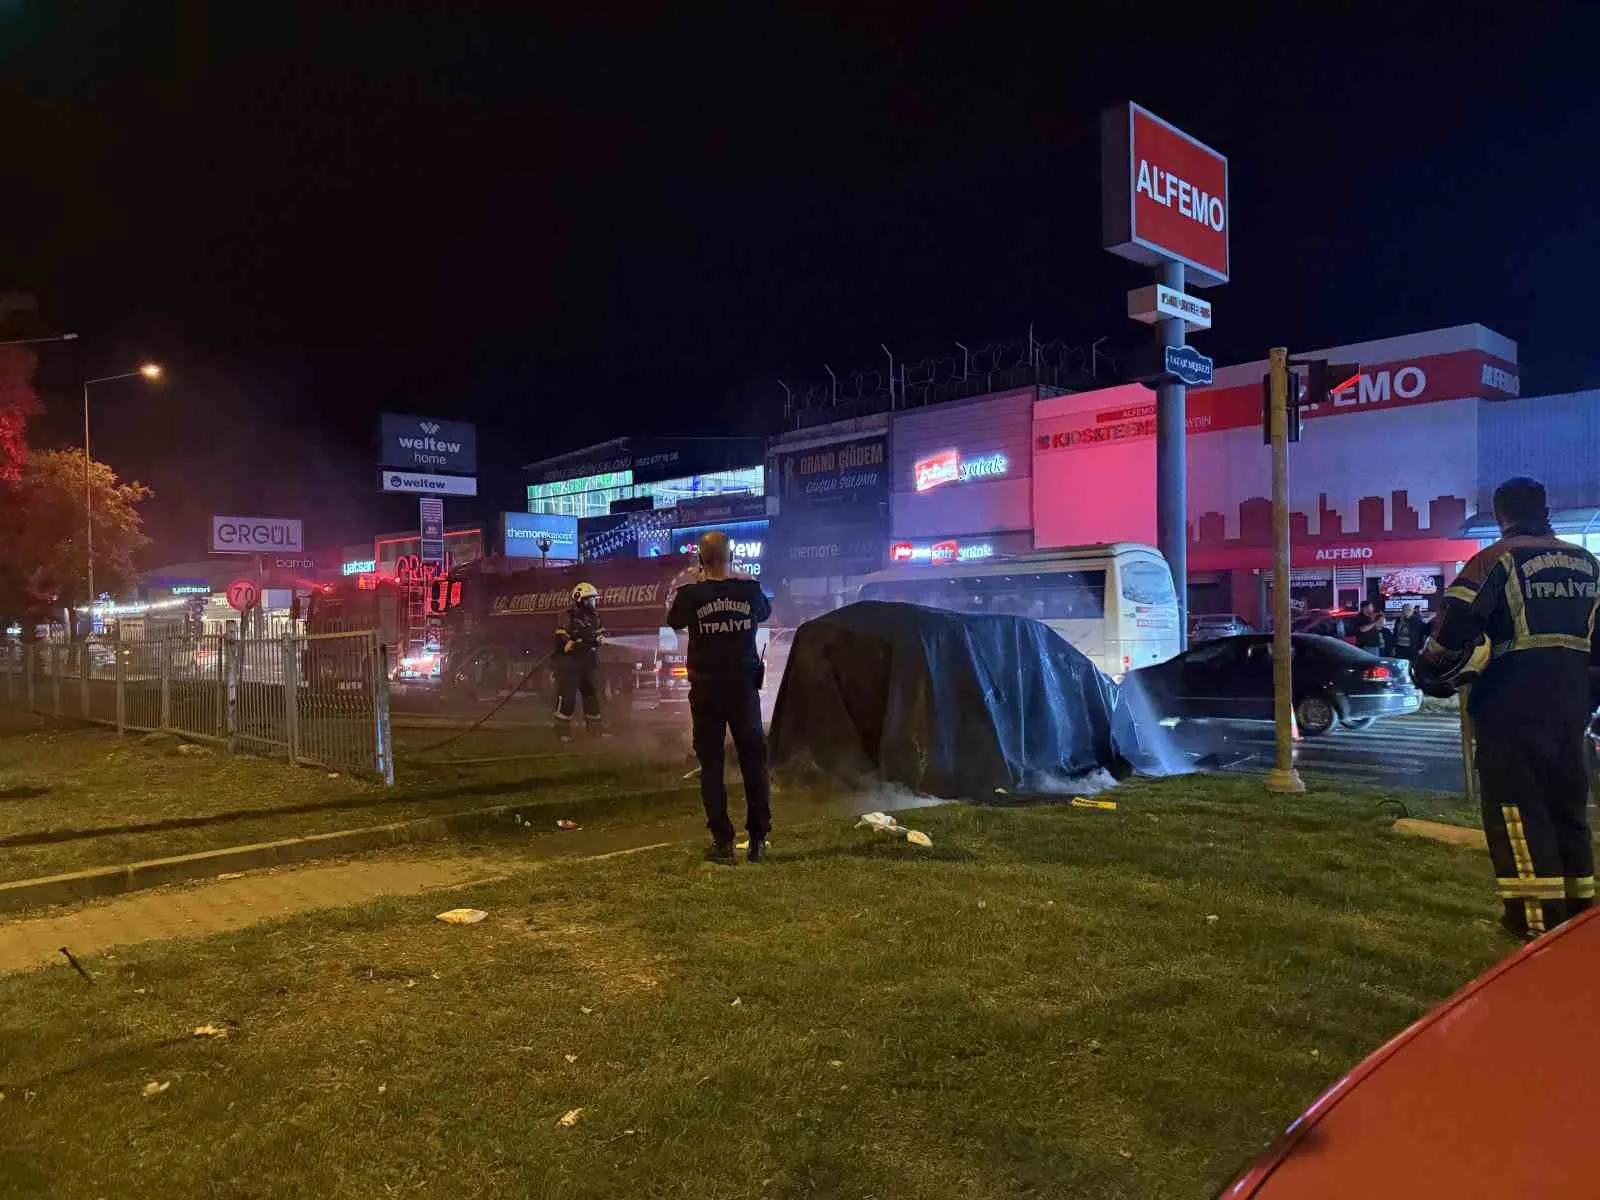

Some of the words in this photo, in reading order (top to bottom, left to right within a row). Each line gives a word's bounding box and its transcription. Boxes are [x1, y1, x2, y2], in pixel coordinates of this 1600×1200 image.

[399, 437, 461, 453] weltew
[414, 452, 447, 465] home
[403, 479, 446, 489] weltew
[232, 587, 254, 602] 70
